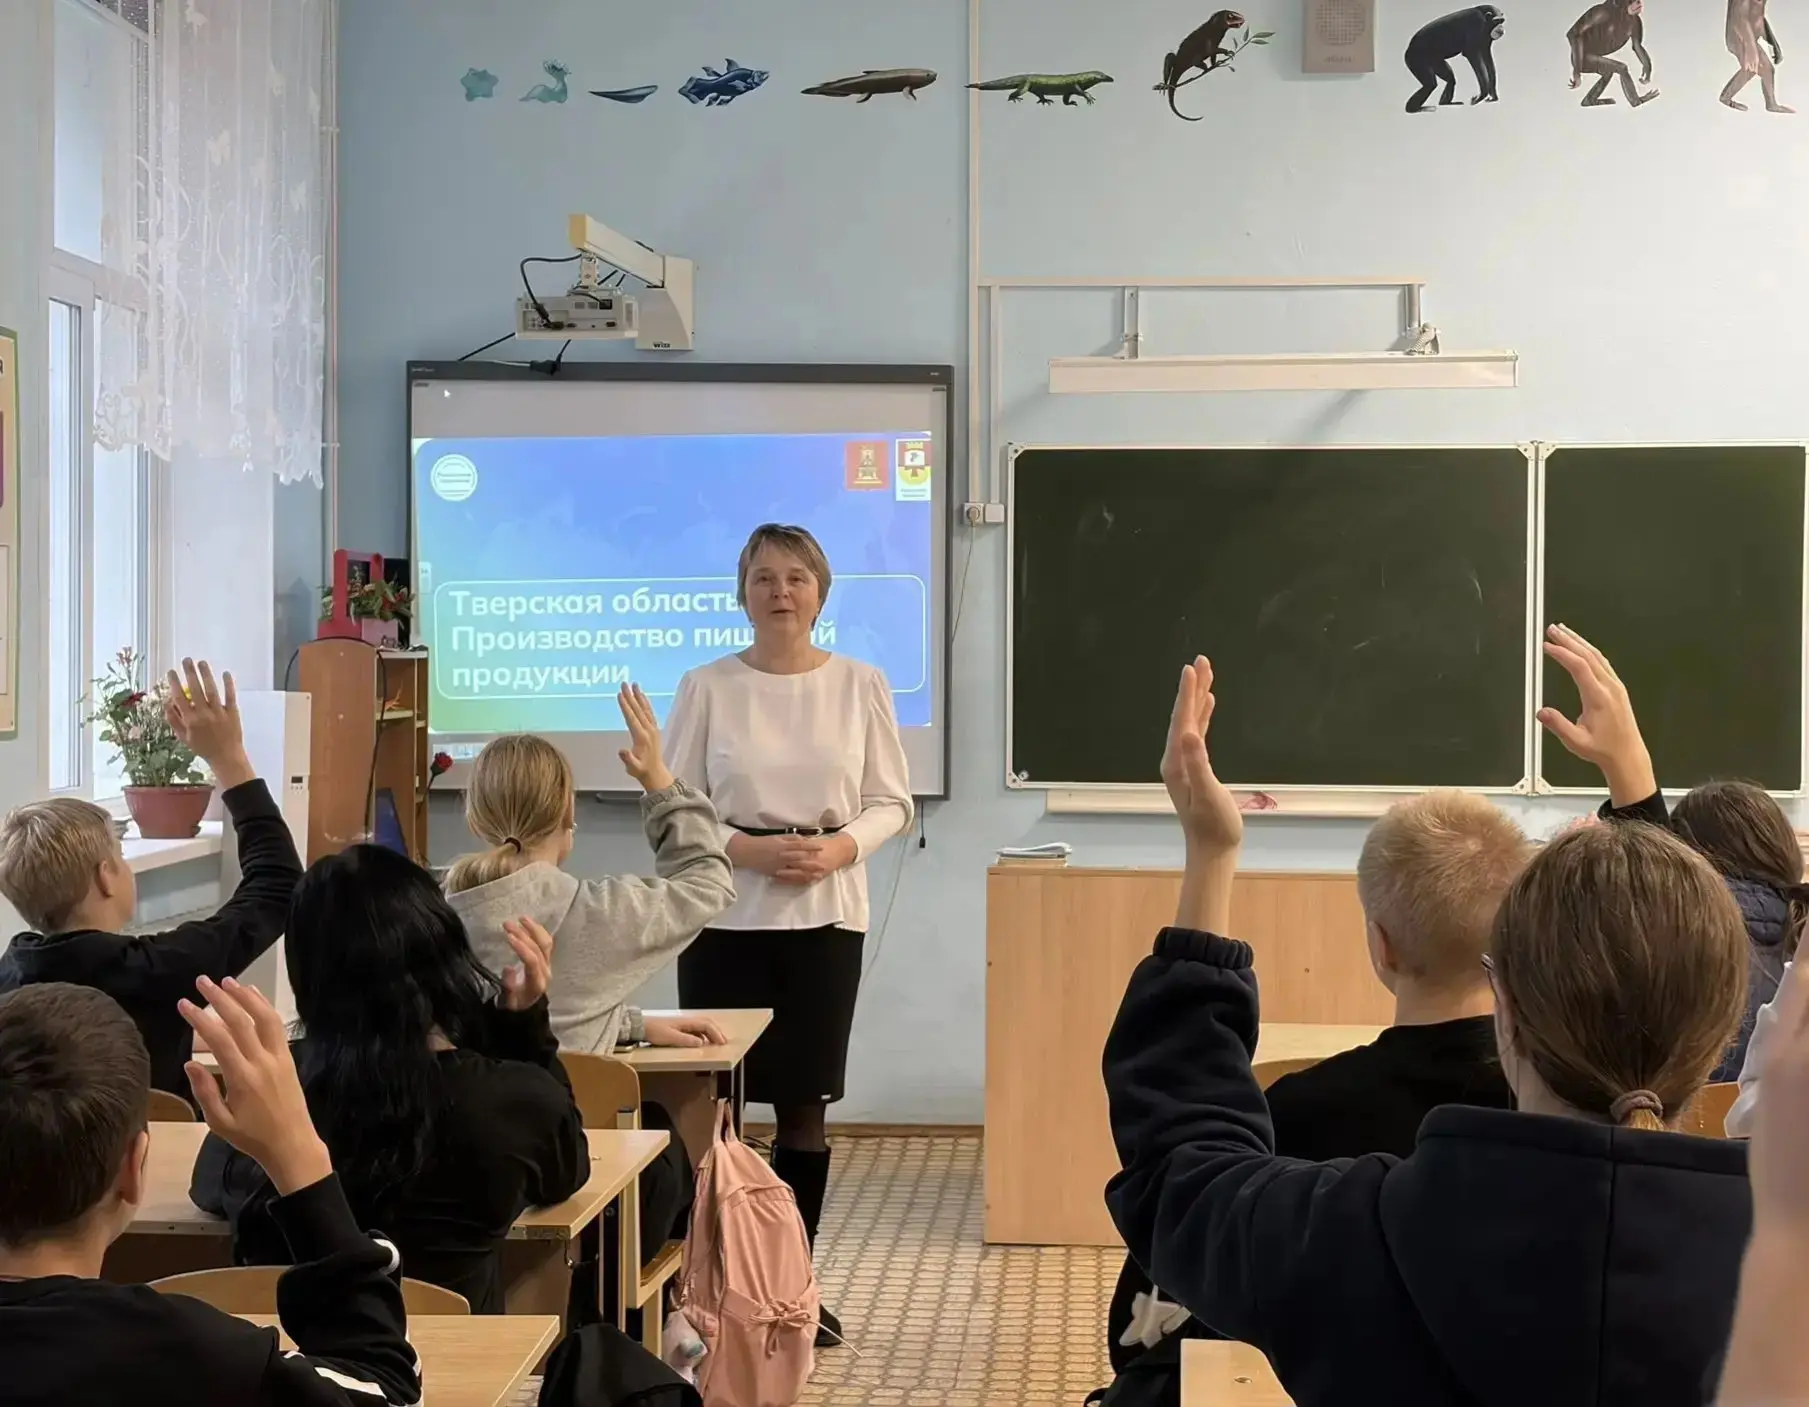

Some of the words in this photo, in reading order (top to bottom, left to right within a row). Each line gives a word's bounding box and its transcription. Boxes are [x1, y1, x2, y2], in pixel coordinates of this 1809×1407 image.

[449, 590, 603, 622] Тверская
[612, 587, 741, 613] область
[452, 626, 684, 658] Производство
[452, 665, 630, 693] продукции
